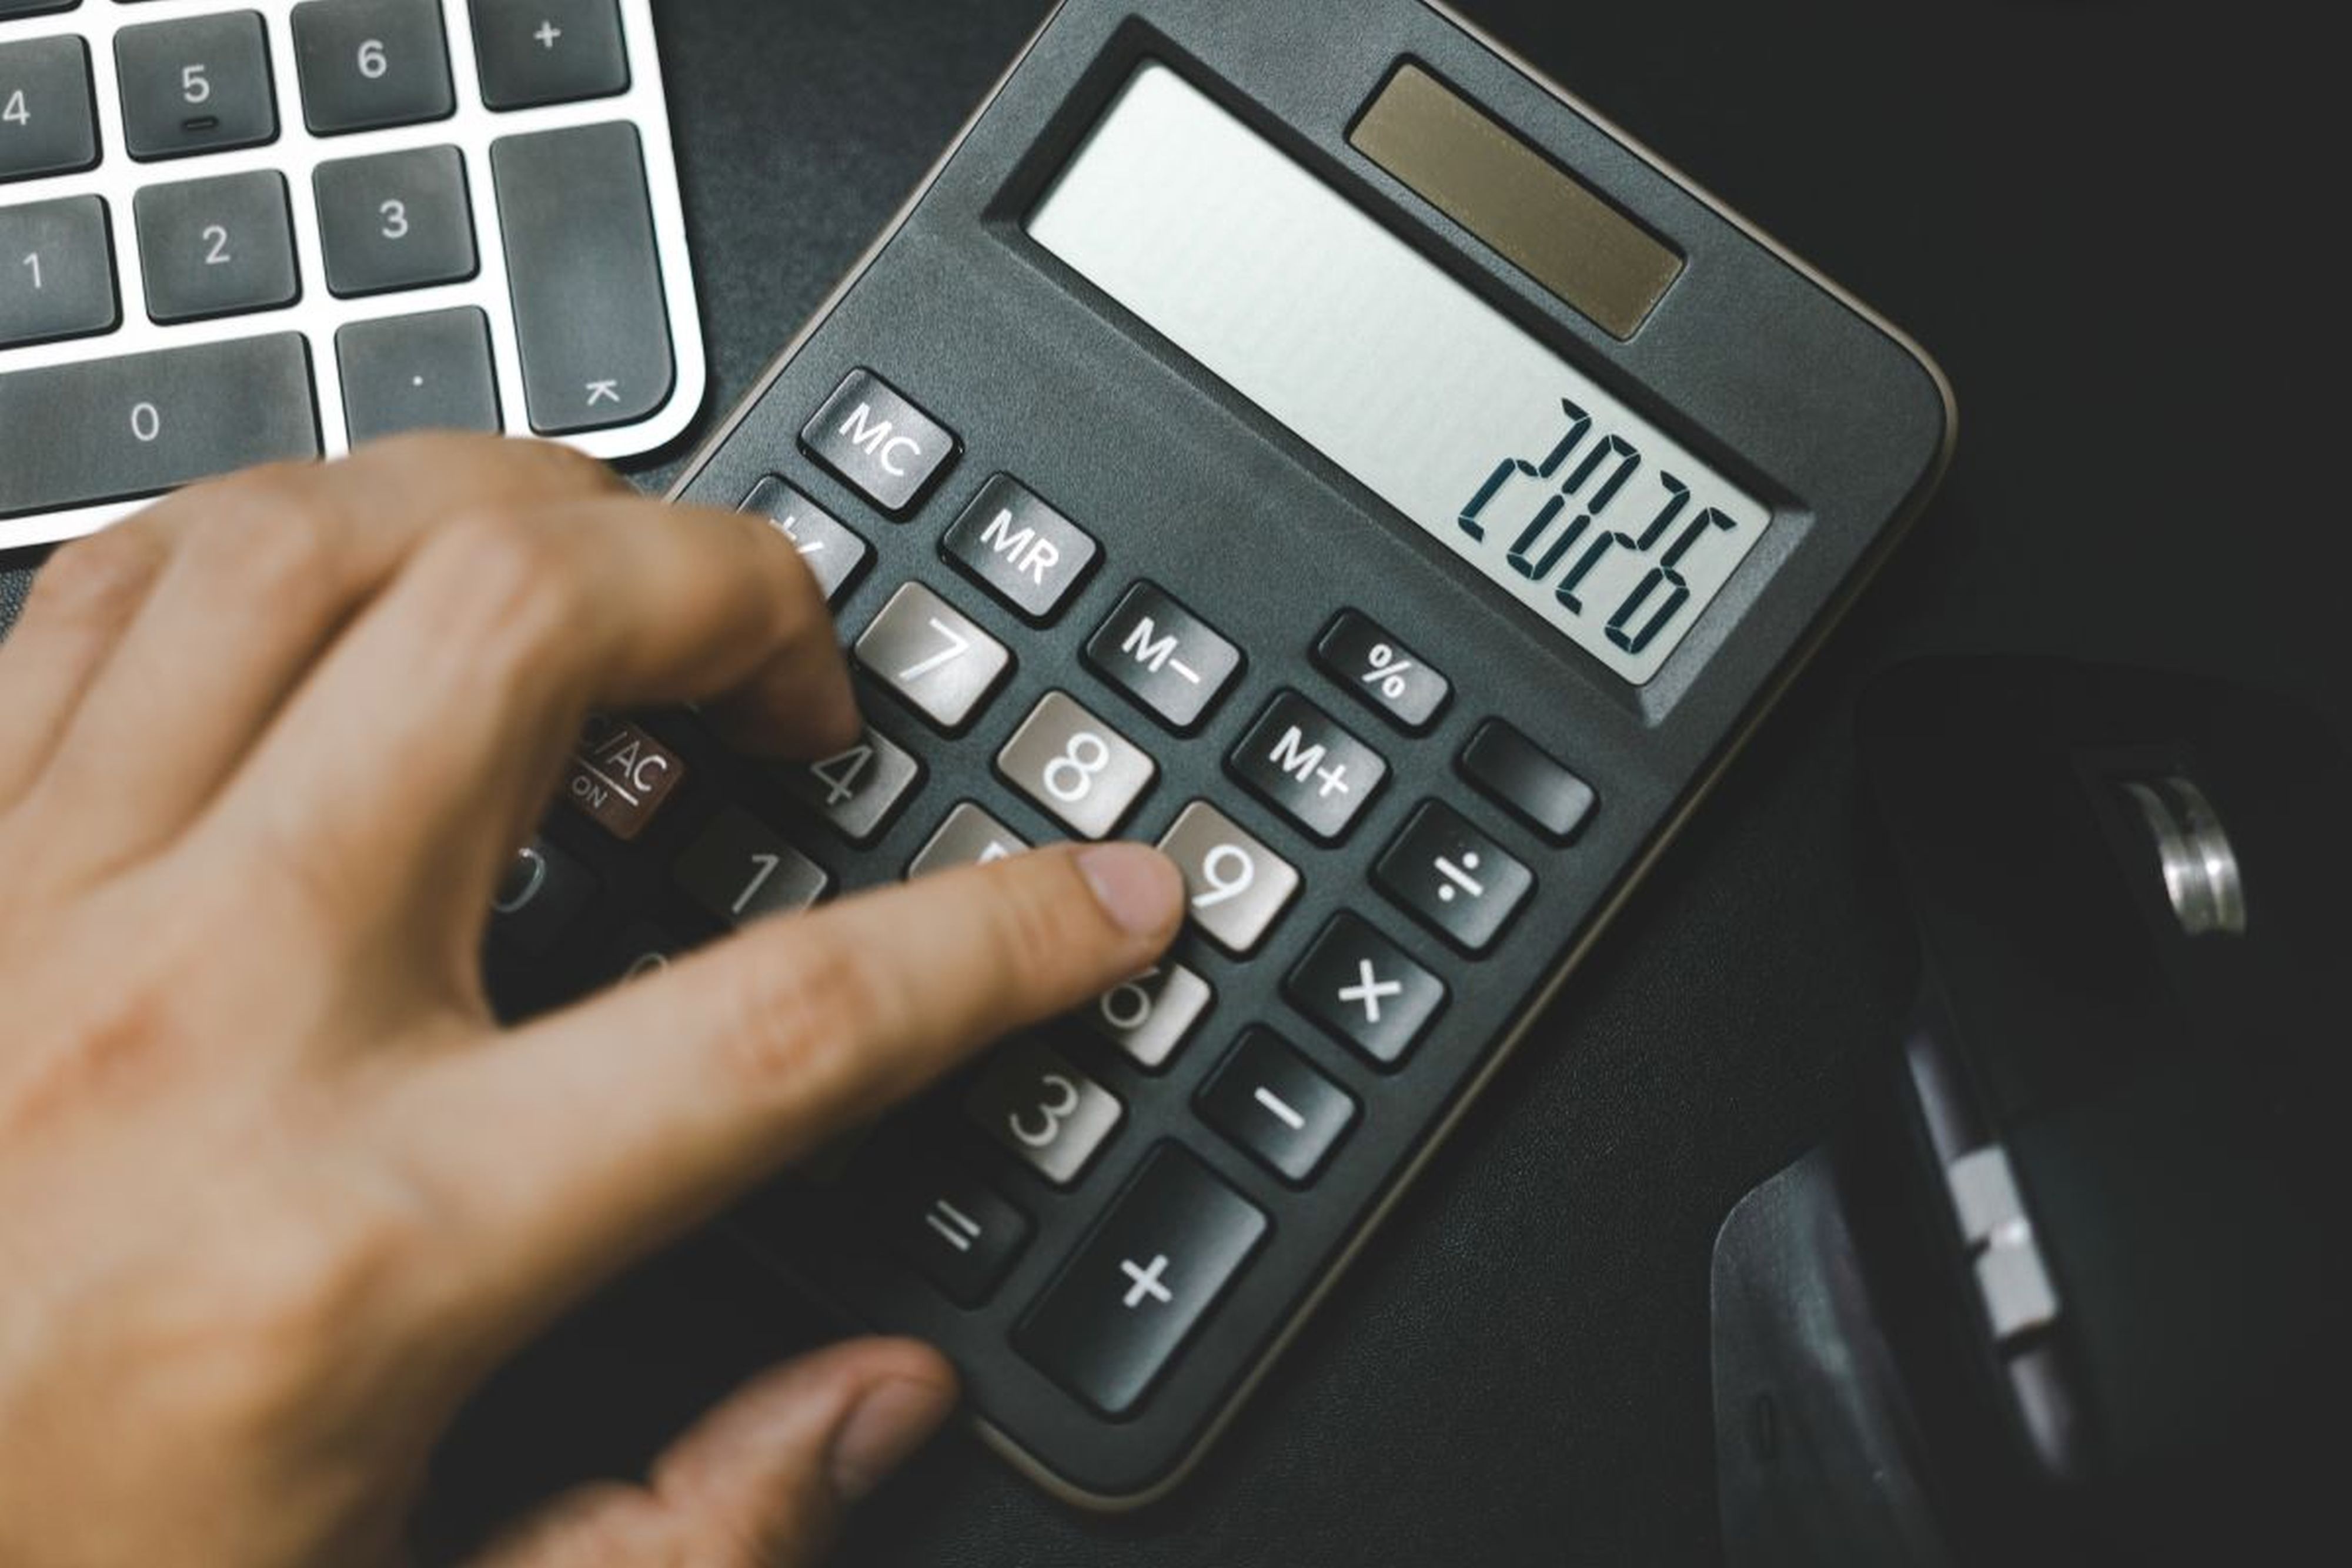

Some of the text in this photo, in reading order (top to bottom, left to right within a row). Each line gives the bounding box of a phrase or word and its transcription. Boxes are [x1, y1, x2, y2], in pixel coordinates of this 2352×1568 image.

[181, 64, 211, 104] 5
[356, 38, 387, 78] 6
[2, 91, 30, 126] 4
[202, 225, 230, 264] 2
[379, 200, 408, 238] 3
[23, 252, 42, 289] 1
[131, 402, 160, 441] 0
[838, 402, 921, 476] MC
[980, 508, 1058, 584] MR
[1458, 397, 1737, 654] 2026
[898, 617, 972, 682] 7
[1361, 644, 1411, 699] %
[809, 744, 872, 804] 4
[1043, 732, 1110, 802] 8
[1268, 725, 1349, 797] M+
[572, 775, 609, 808] ON
[732, 854, 779, 914] 1
[1191, 844, 1254, 908] 9
[1100, 965, 1160, 1029] 6
[1009, 1075, 1078, 1146] 3
[926, 1199, 981, 1251] =
